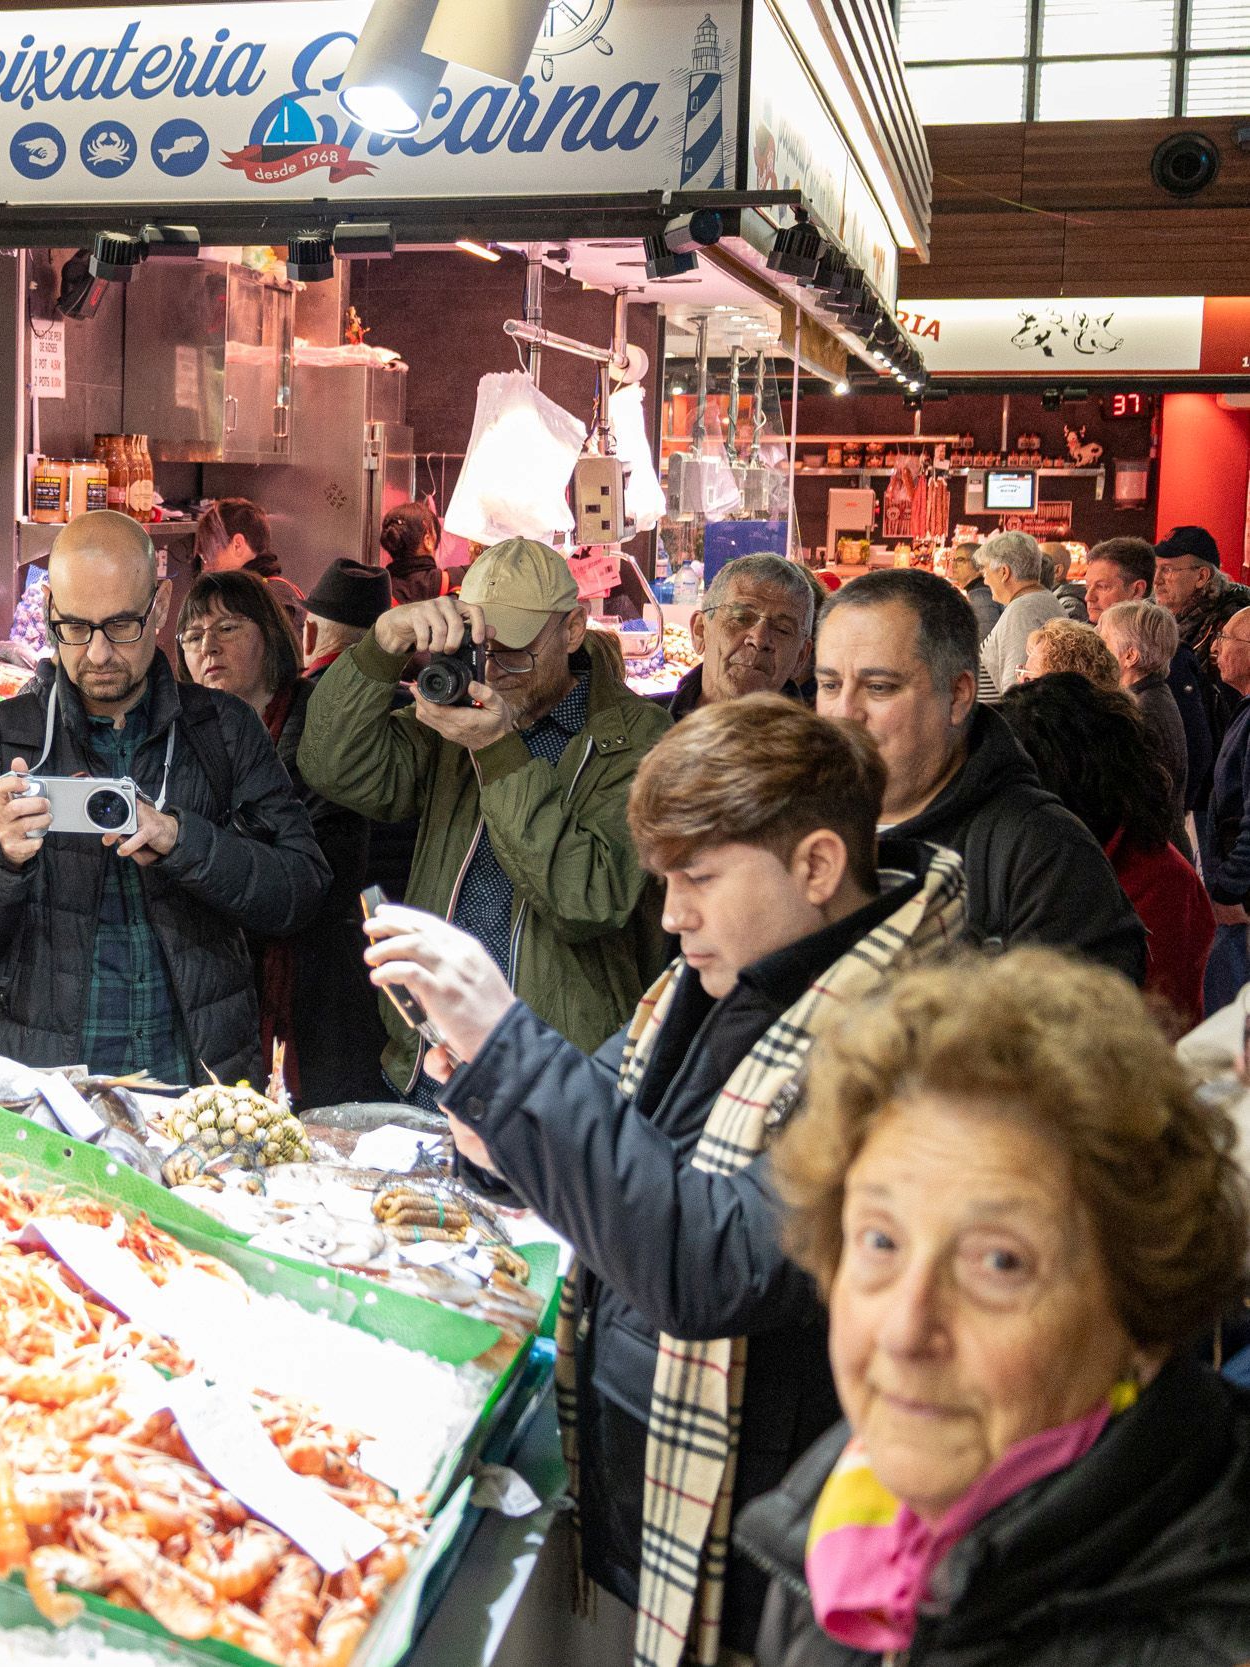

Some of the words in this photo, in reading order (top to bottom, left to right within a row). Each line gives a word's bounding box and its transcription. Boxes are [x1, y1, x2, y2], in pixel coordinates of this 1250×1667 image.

[254, 162, 298, 181] desde
[302, 150, 340, 169] 1968
[1113, 393, 1140, 416] 37
